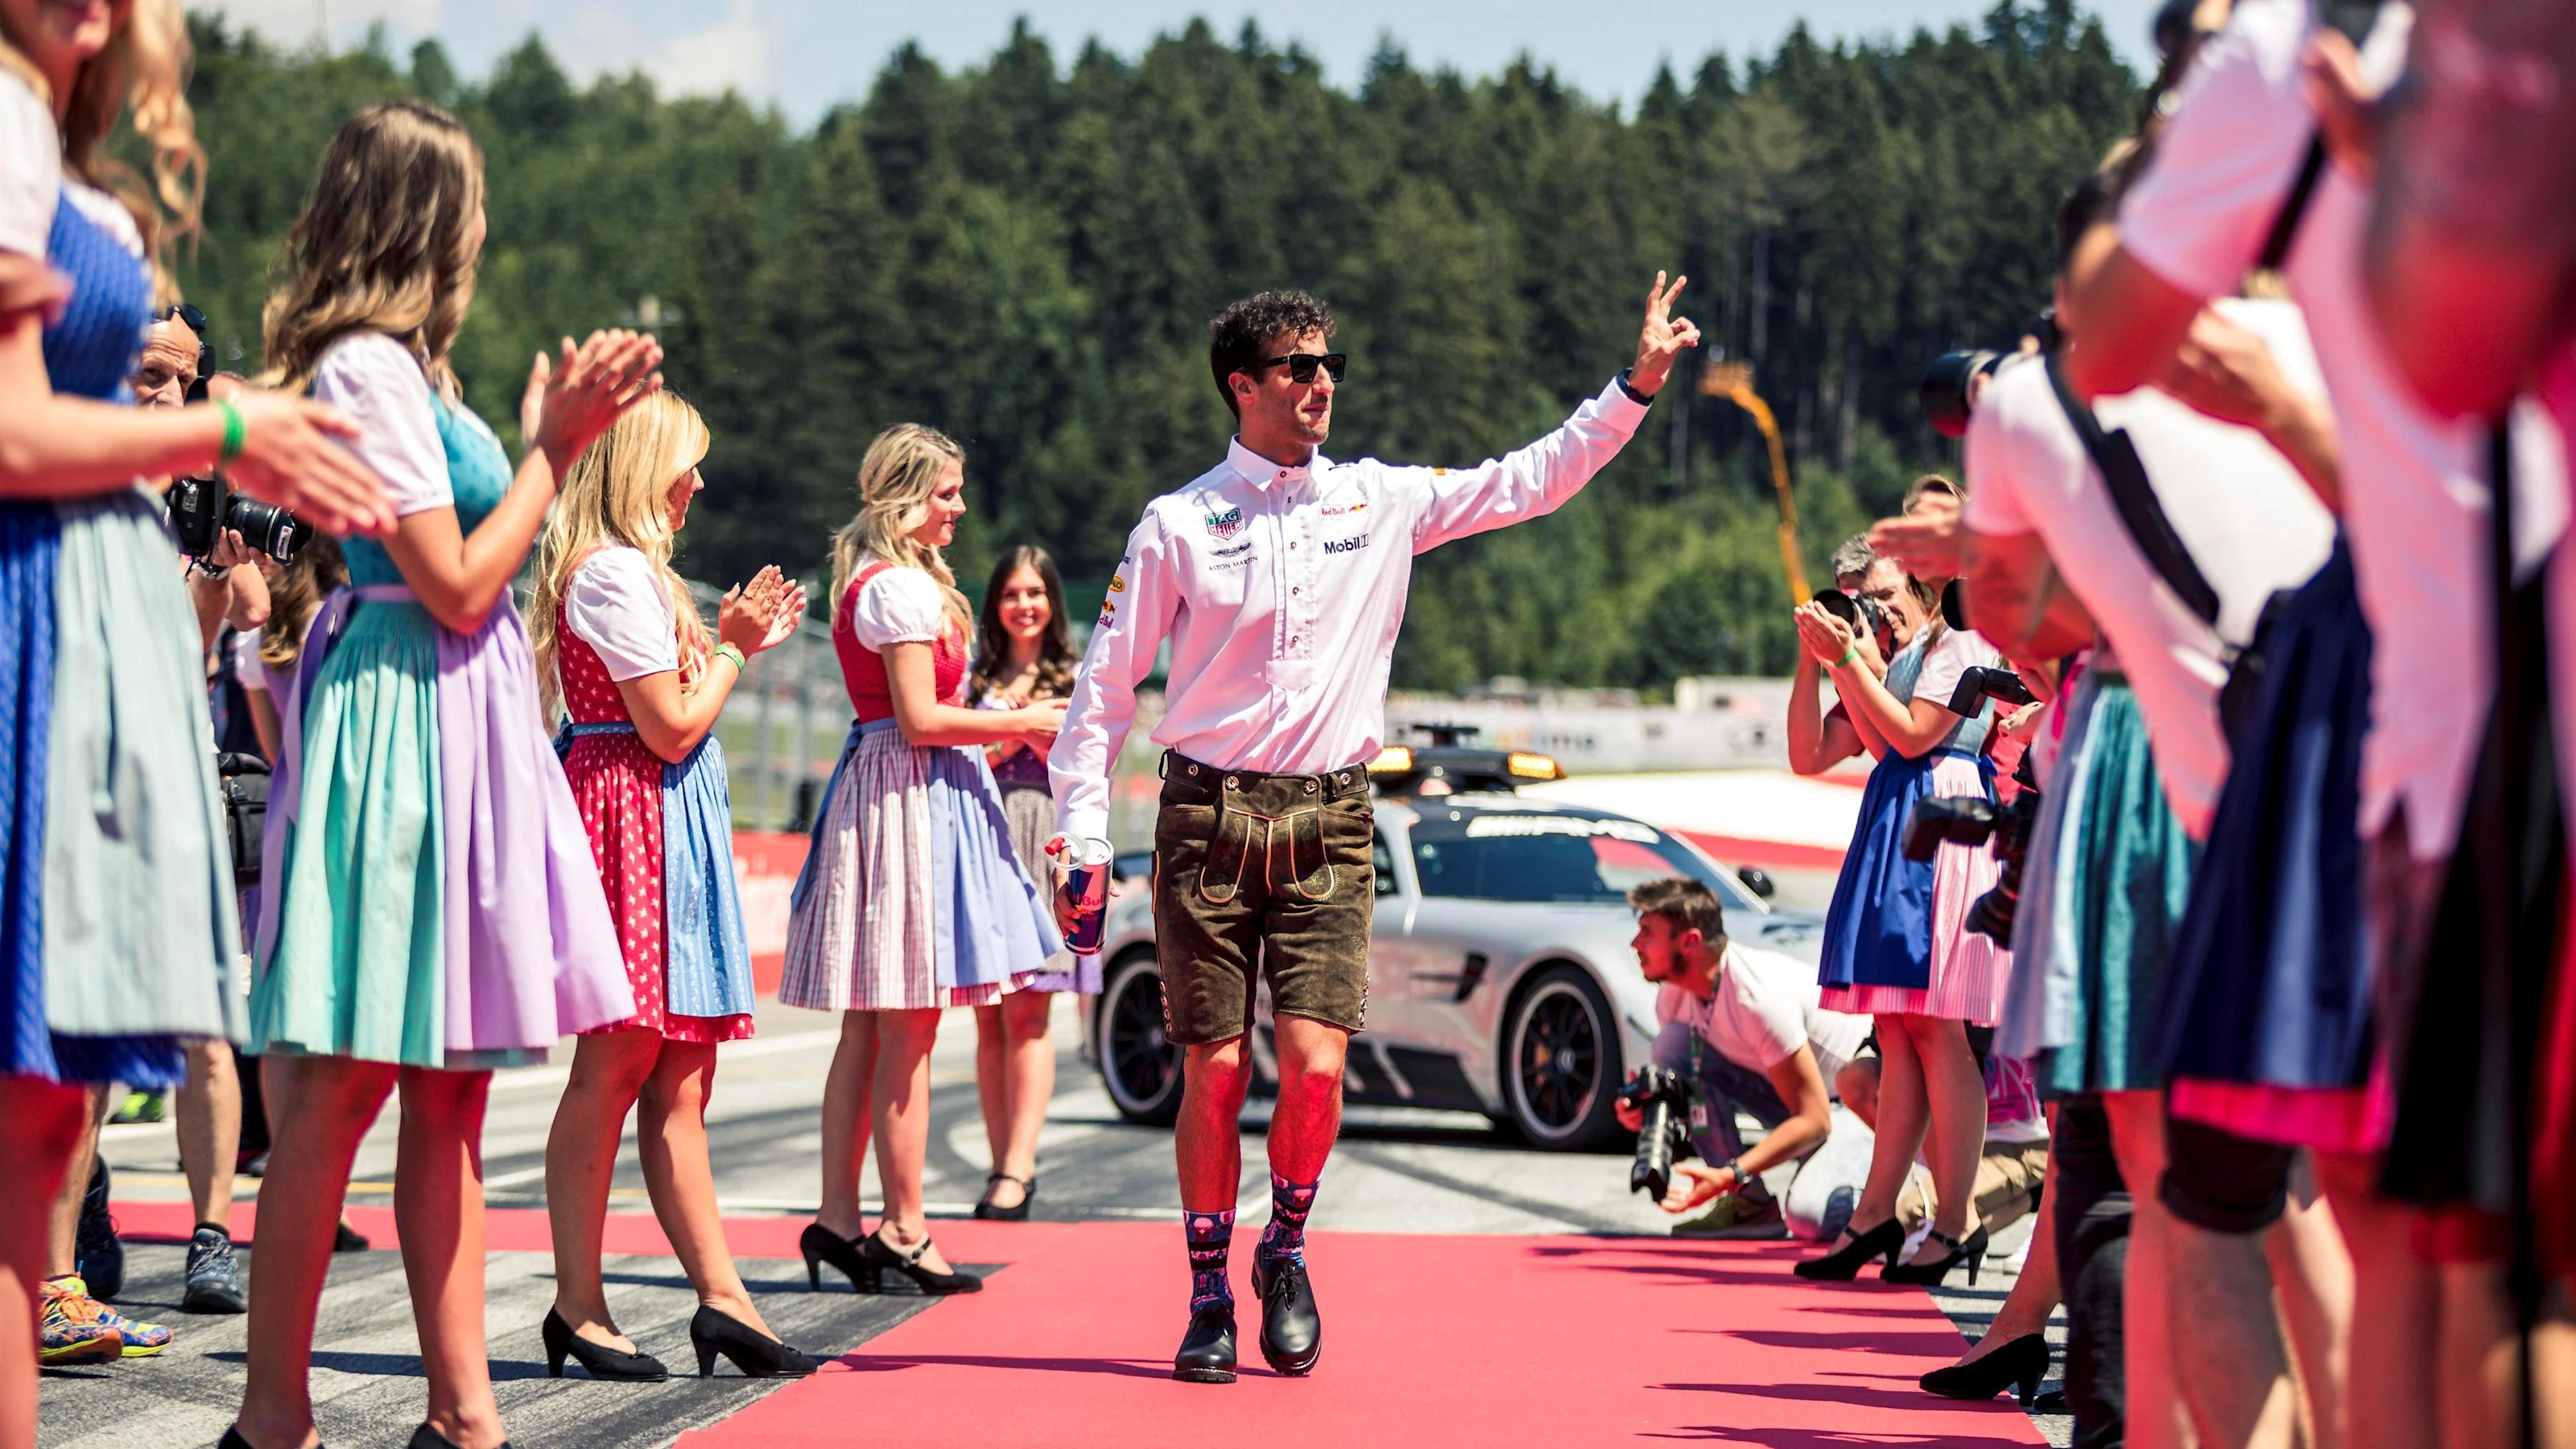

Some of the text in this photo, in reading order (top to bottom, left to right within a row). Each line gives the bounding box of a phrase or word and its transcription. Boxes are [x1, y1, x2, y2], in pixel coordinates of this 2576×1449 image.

[1208, 511, 1238, 525] TAG
[1321, 507, 1345, 515] Red Bull
[1209, 522, 1241, 538] HEUER
[1323, 536, 1360, 555] Mobil
[1209, 555, 1257, 572] ASTON MARTIN
